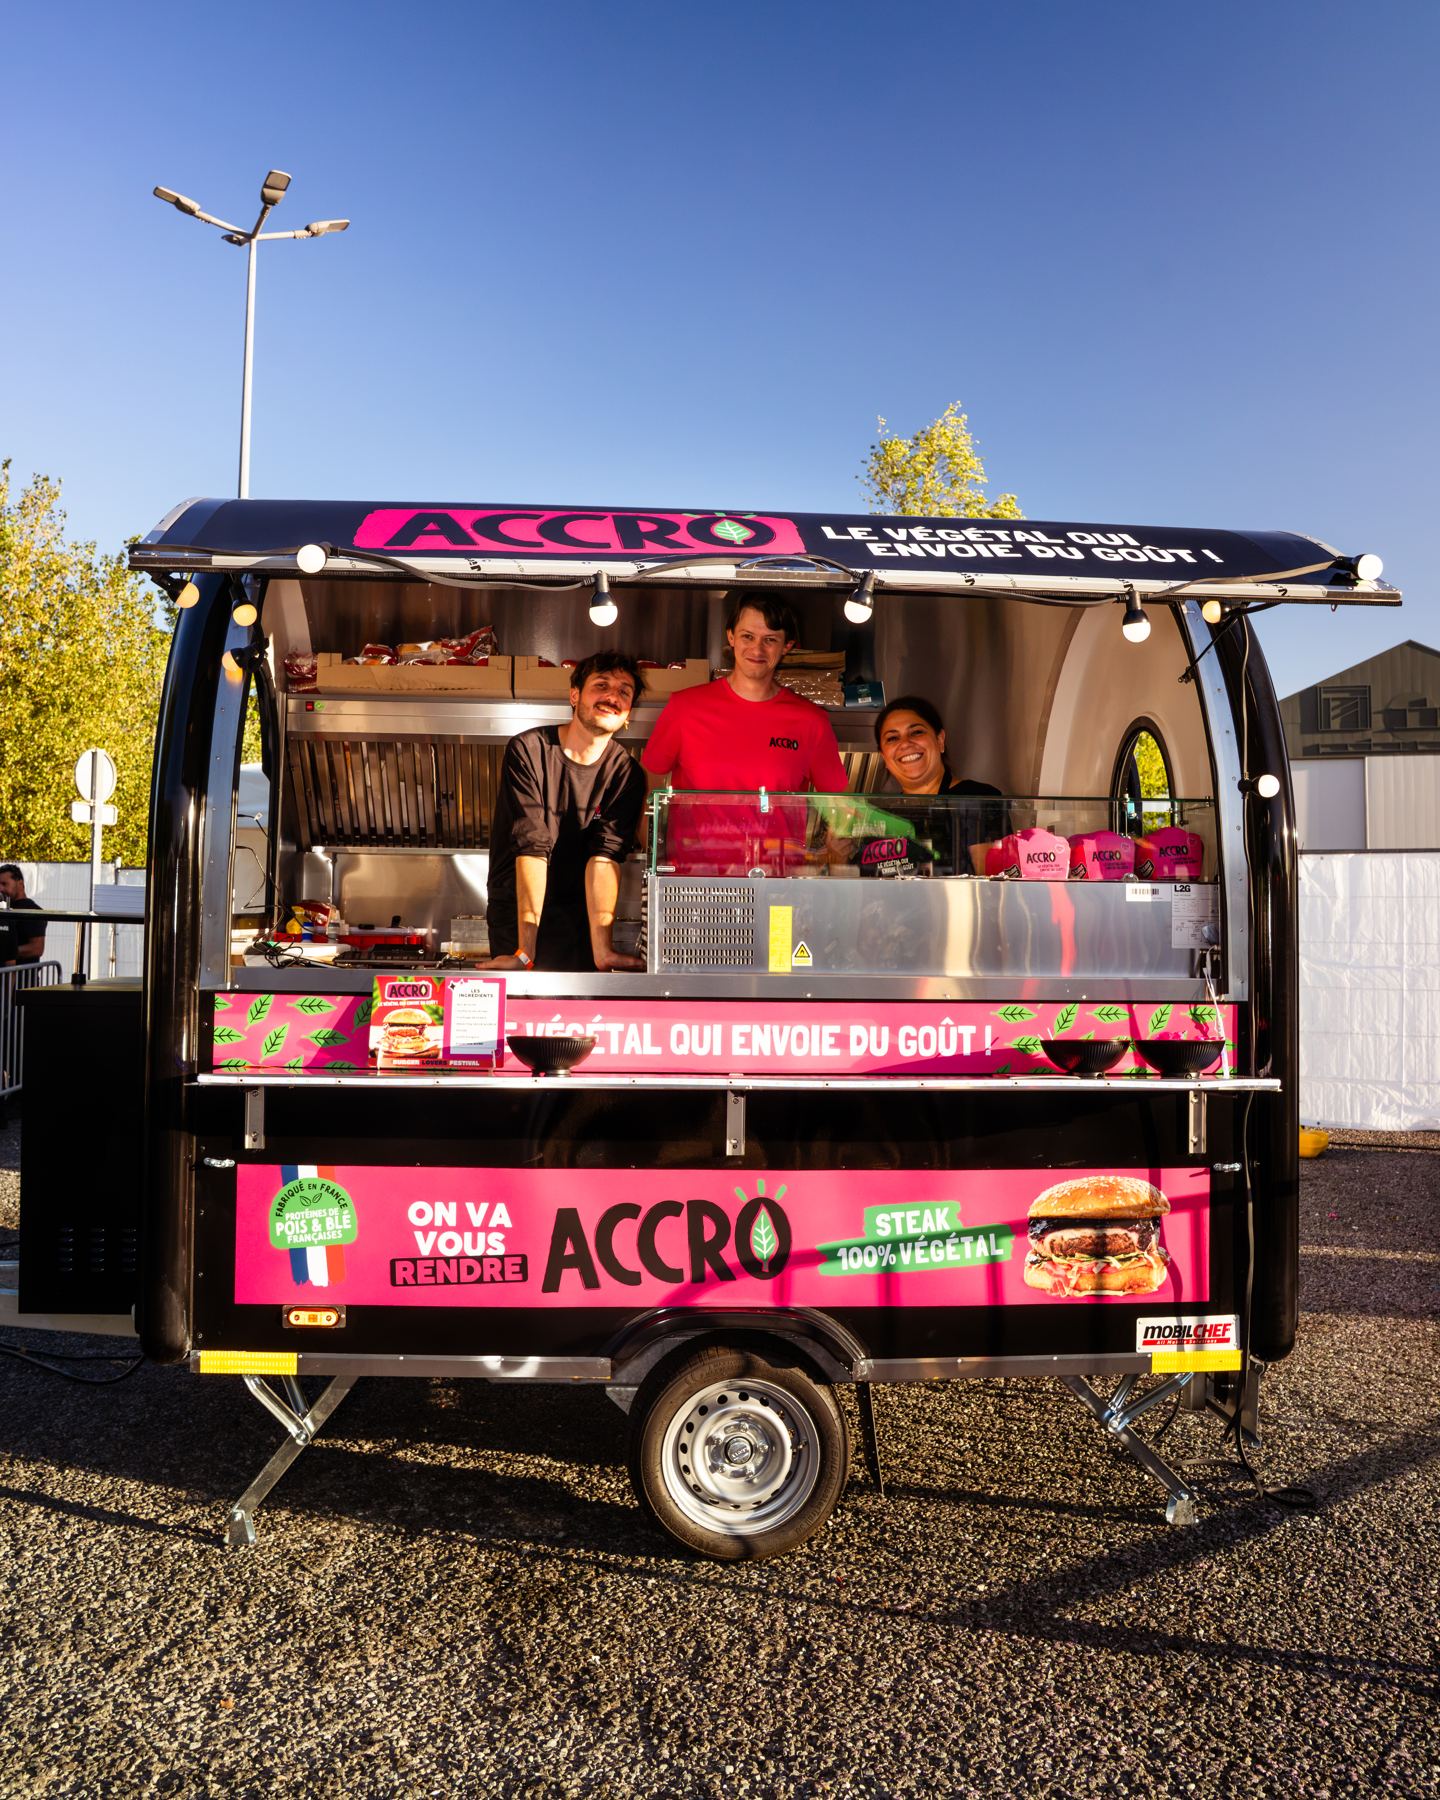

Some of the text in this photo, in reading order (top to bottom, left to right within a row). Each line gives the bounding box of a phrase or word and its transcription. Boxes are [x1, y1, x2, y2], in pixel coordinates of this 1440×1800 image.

[383, 511, 779, 552] ACCRO
[821, 526, 1141, 546] LE VÉGÉTAL QUI
[865, 543, 1224, 563] ENVOIE DU GOÛT !
[769, 737, 798, 750] ACCRO
[864, 839, 903, 862] ACCRO
[1026, 852, 1056, 864] ACCRO
[1092, 850, 1122, 862] ACCRO
[1159, 845, 1189, 857] ACCRO
[1174, 884, 1191, 892] L2G
[389, 983, 428, 998] ACCRO
[670, 1023, 721, 1056] QUI
[733, 1024, 842, 1056] ENVOIE
[850, 1025, 892, 1056] DU
[898, 1017, 977, 1056] GOÛT
[984, 1025, 992, 1056] !
[276, 1181, 305, 1217] FABRIQUÉ
[320, 1183, 348, 1209] FRANCE
[275, 1210, 352, 1236] POIS & BLÉ
[285, 1208, 339, 1221] PROTÉINES DE
[407, 1200, 513, 1228] ON VA
[875, 1206, 950, 1237] STEAK
[287, 1230, 343, 1244] FRANÇAISES
[414, 1231, 506, 1257] VOUS
[541, 1196, 792, 1294] ACCRO
[836, 1233, 1004, 1271] 100% VÉGÉTAL
[397, 1258, 523, 1285] RENDRE
